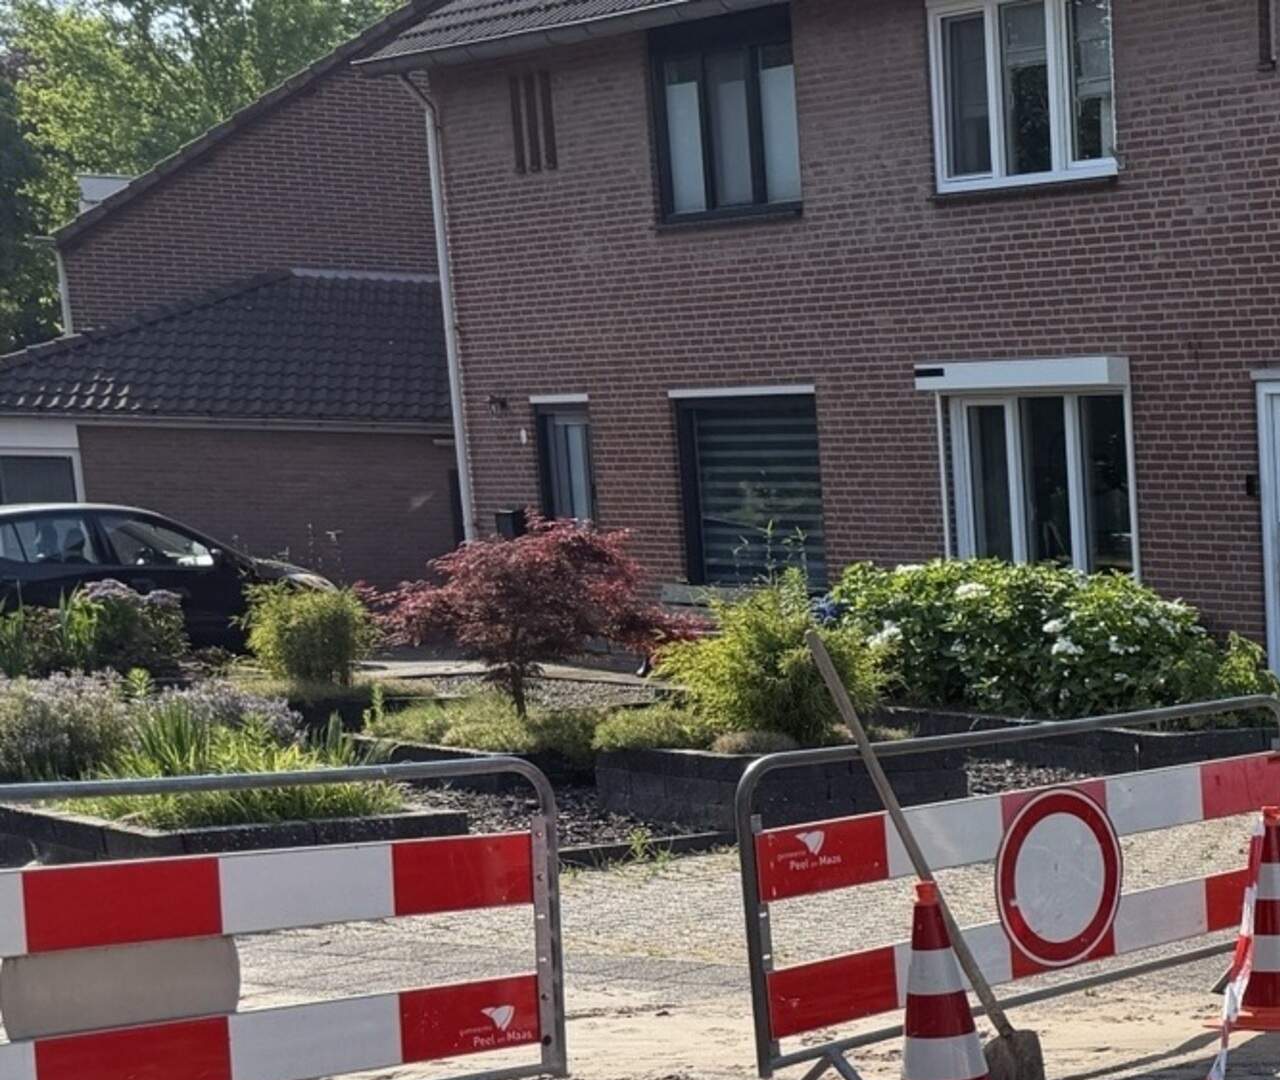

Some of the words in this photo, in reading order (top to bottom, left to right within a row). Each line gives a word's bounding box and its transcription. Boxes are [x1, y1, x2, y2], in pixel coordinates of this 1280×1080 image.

[789, 858, 809, 871] Peel
[819, 855, 842, 866] Maas
[473, 1033, 496, 1047] Peel
[506, 1030, 533, 1042] Maas
